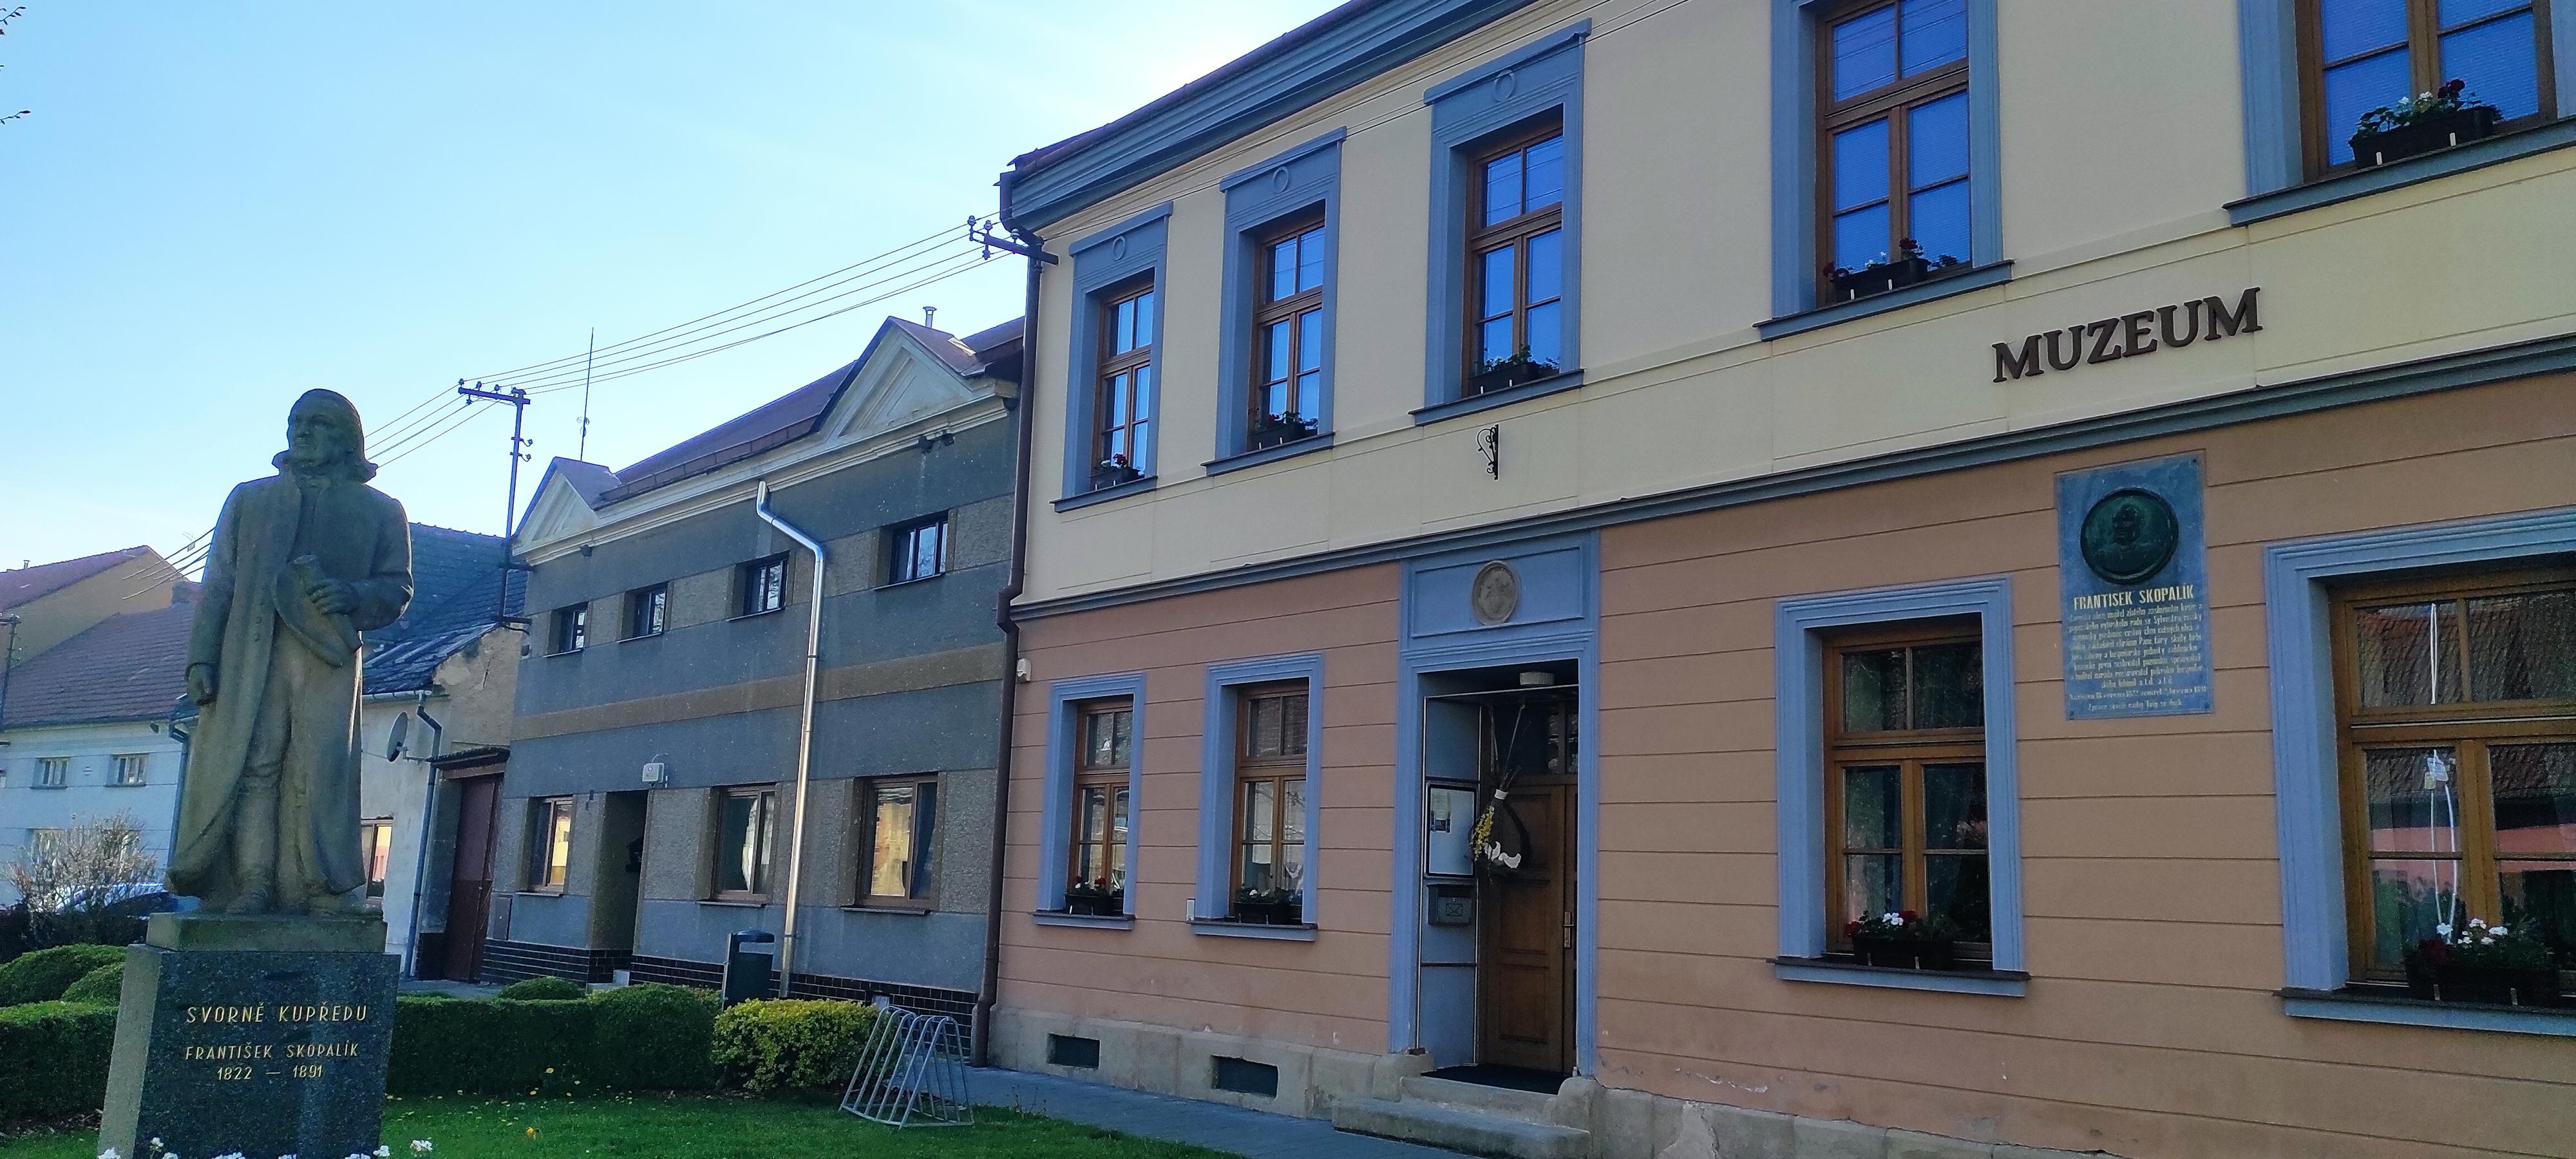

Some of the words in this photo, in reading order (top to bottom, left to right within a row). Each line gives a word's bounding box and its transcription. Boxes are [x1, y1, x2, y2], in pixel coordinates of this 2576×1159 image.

[1991, 287, 2263, 383] MUZEUM
[186, 1003, 265, 1024] SVORNĚ
[278, 1001, 368, 1022] KUPŘEDU
[185, 1041, 273, 1060] FRANTIŠEK
[286, 1039, 360, 1058] SKOPALÍK
[216, 1066, 252, 1080] 1822
[292, 1064, 323, 1079] 1891
